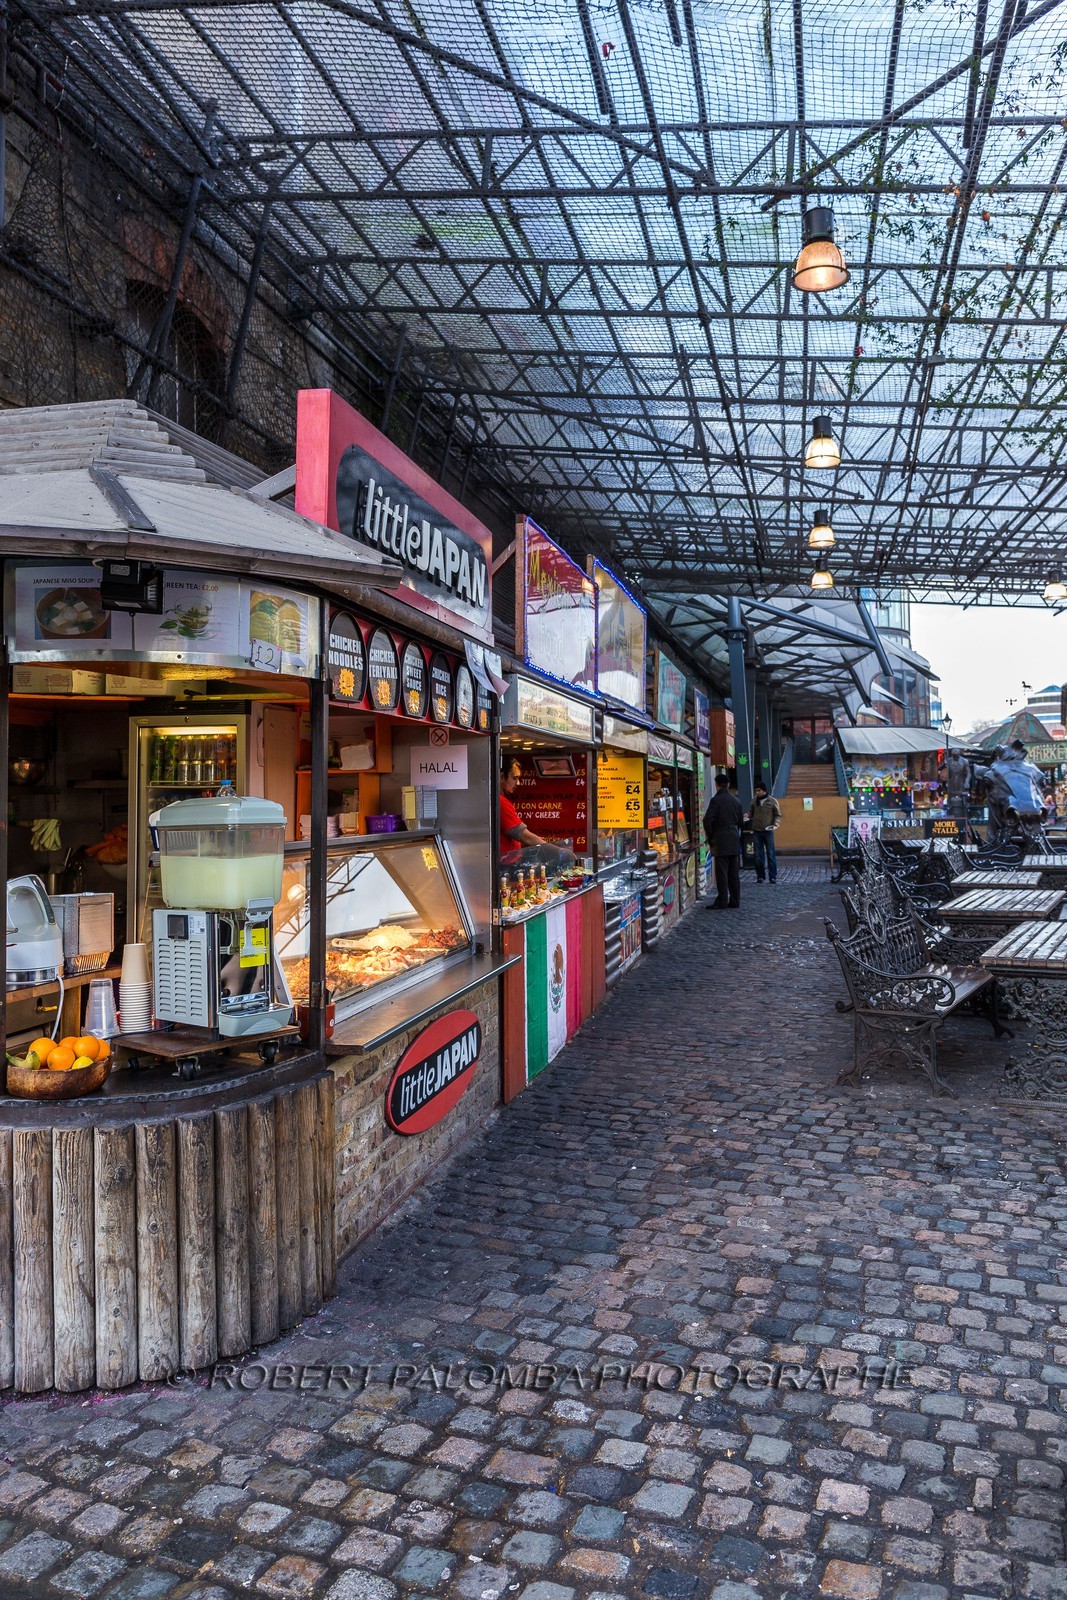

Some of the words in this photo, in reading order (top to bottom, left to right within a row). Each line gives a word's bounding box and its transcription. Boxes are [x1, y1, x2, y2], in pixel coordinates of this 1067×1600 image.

[186, 583, 200, 591] TEA:
[201, 584, 219, 592] £2.00
[329, 633, 362, 655] CHICKEN
[328, 649, 364, 671] NOODLES
[369, 648, 396, 664] CHICKEN
[403, 653, 424, 669] CHICKEN
[368, 664, 398, 679] TERIYAKI
[406, 665, 422, 680] SWEET
[431, 666, 451, 684] CHICKEN
[406, 677, 422, 692] SAUCE
[435, 682, 447, 697] RICE
[419, 762, 458, 773] HALAL
[576, 768, 586, 777] £5
[575, 778, 586, 786] £4
[625, 784, 641, 795] £4
[520, 802, 537, 810] CON
[538, 802, 563, 810] CARNE
[576, 802, 586, 810] £5
[625, 801, 641, 811] £5
[535, 811, 561, 819] CHEESE
[576, 811, 586, 820] £4
[887, 819, 917, 828] SINCE
[933, 820, 957, 828] MORE
[576, 836, 586, 845] £5
